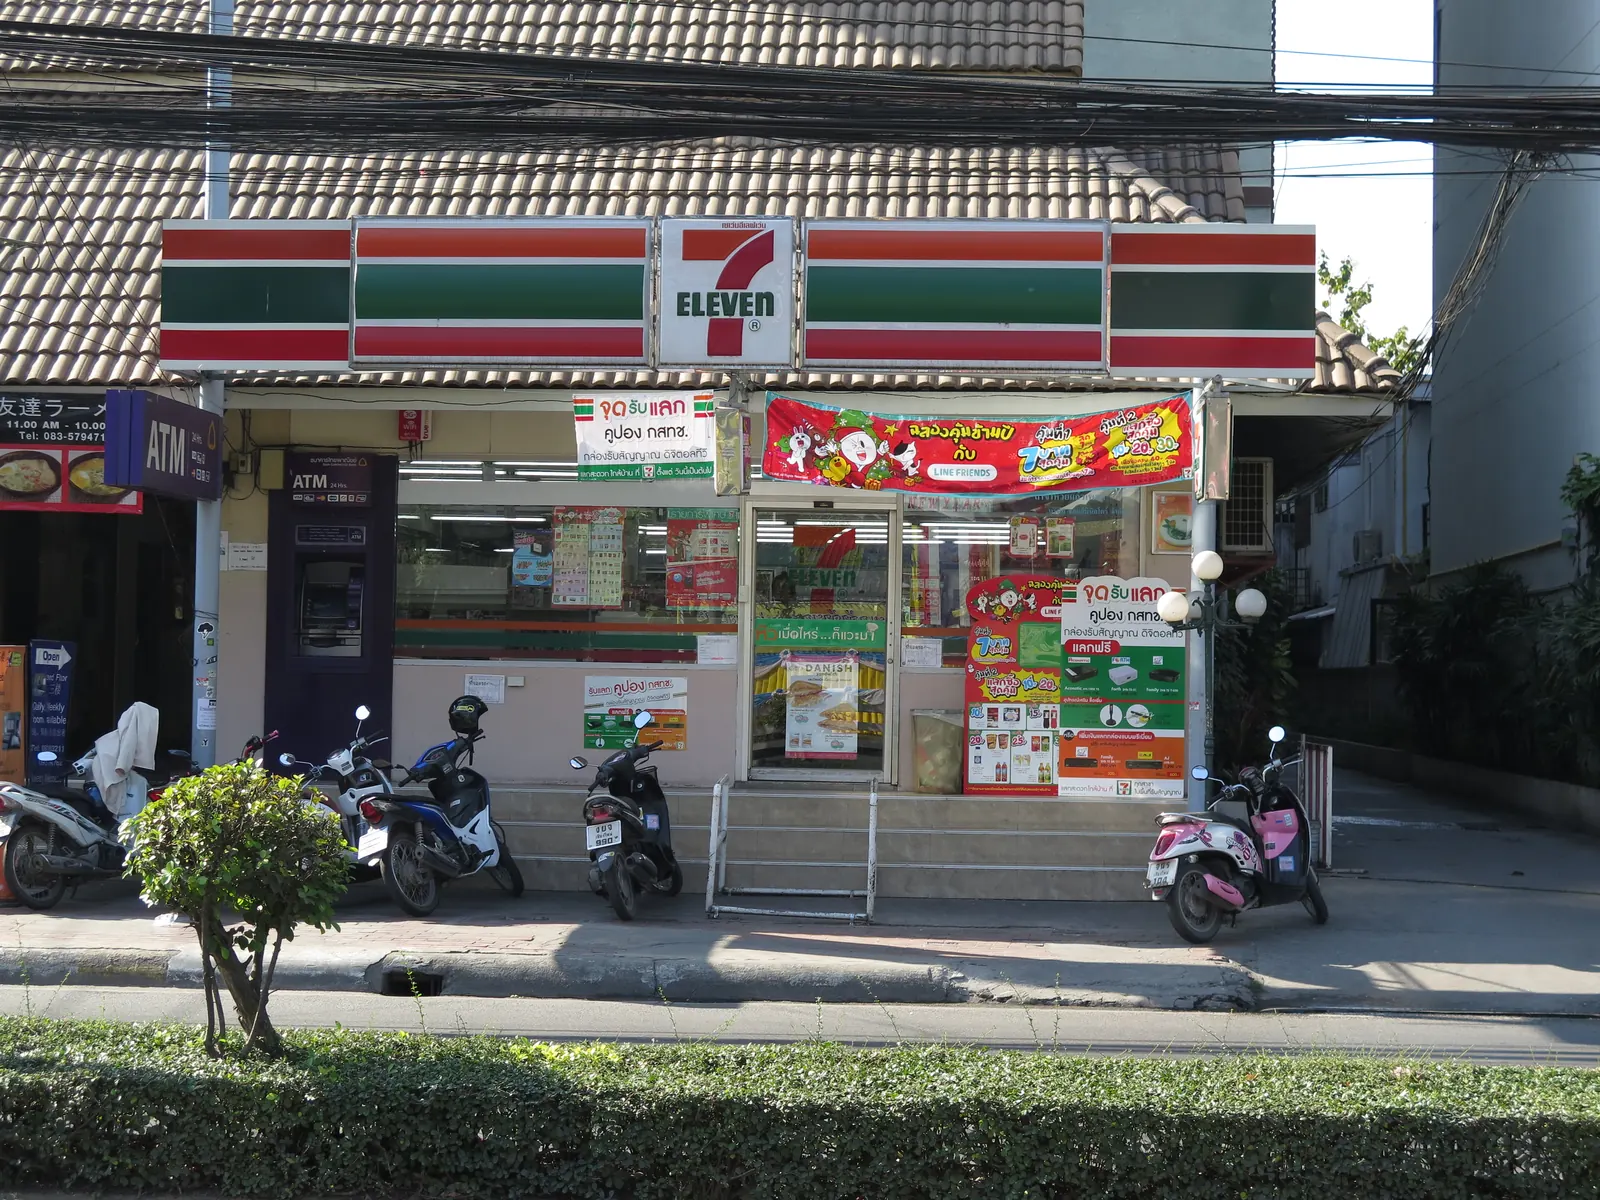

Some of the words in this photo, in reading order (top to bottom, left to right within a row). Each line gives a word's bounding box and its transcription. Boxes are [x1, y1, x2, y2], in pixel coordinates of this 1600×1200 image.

[682, 229, 775, 356] 7
[7, 420, 38, 430] 11.00
[42, 421, 60, 430] AM
[19, 431, 39, 441] Tel:
[604, 424, 642, 443] คูปอง
[647, 425, 688, 439] กสทช.
[907, 421, 1016, 445] ฉลองคุ้มข้ามปี
[146, 419, 185, 478] ATM
[583, 450, 661, 462] กล่องรับสัญญาณ
[663, 447, 708, 459] ดิจิตอลทีวี
[952, 443, 977, 460] กับ
[934, 468, 954, 476] LINE
[956, 468, 991, 477] FRIENDS
[292, 474, 328, 489] ATM
[1089, 607, 1123, 624] คูปอง
[1063, 626, 1139, 639] กล่องรับสัญญาณ
[1072, 641, 1112, 653] แลกฟรี
[42, 650, 60, 662] Open
[805, 664, 853, 673] DANISH
[613, 680, 645, 697] คูปอง
